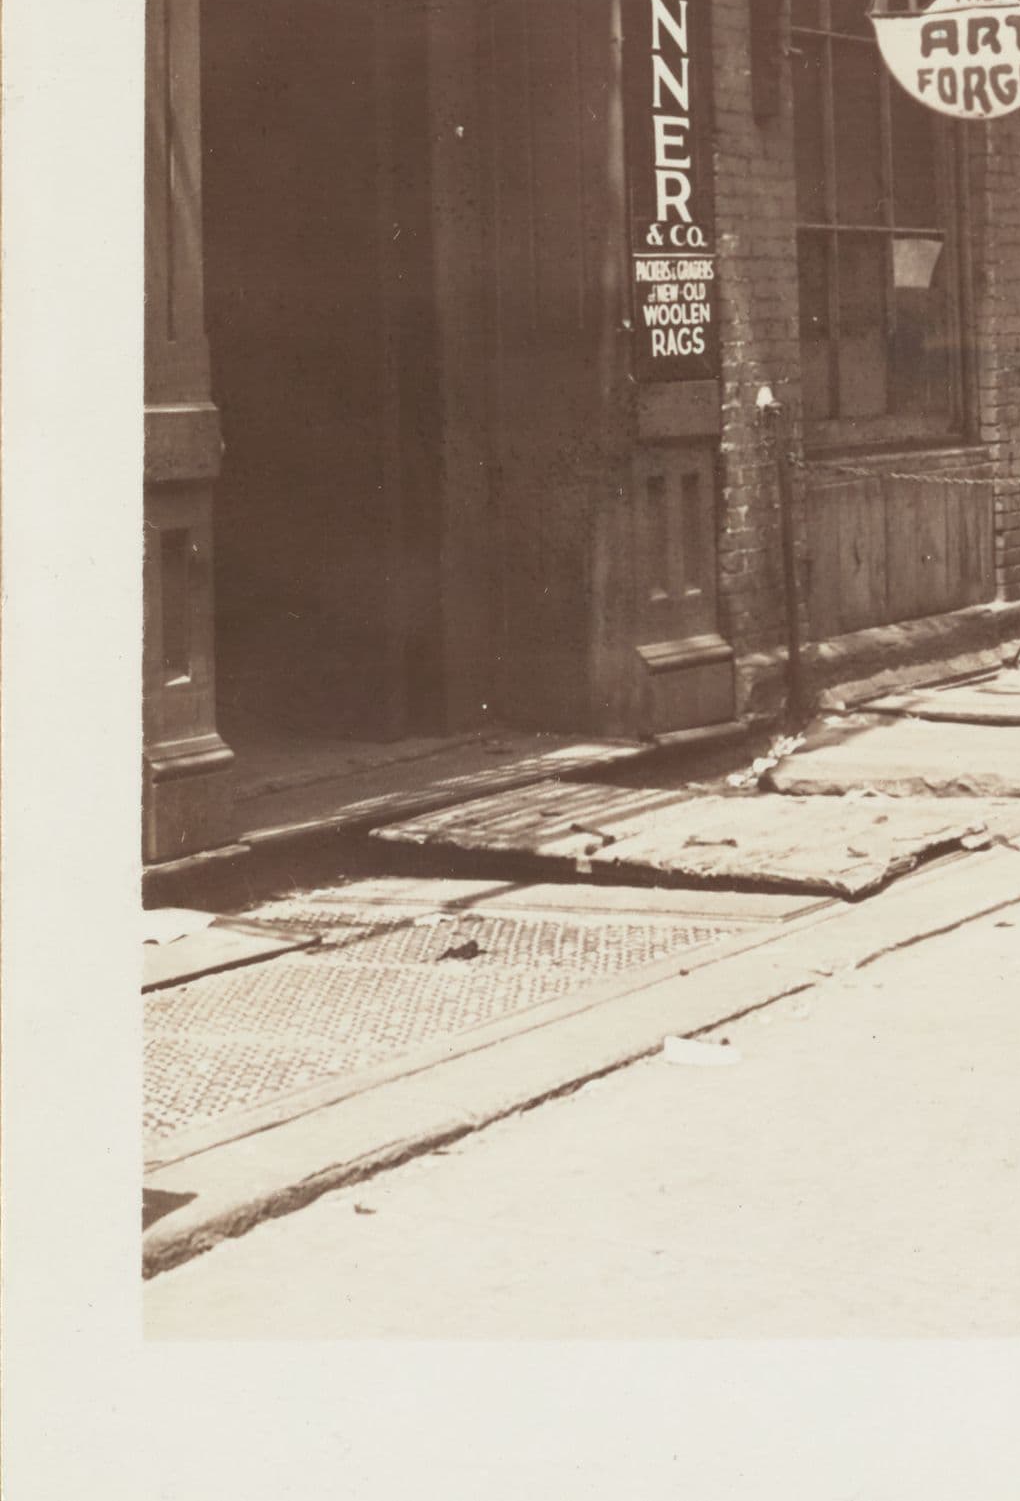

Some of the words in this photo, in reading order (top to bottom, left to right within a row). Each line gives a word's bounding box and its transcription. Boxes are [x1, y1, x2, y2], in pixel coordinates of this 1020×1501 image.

[646, 223, 664, 246] &
[643, 303, 710, 326] WOOLEN
[652, 326, 705, 357] RAGS
